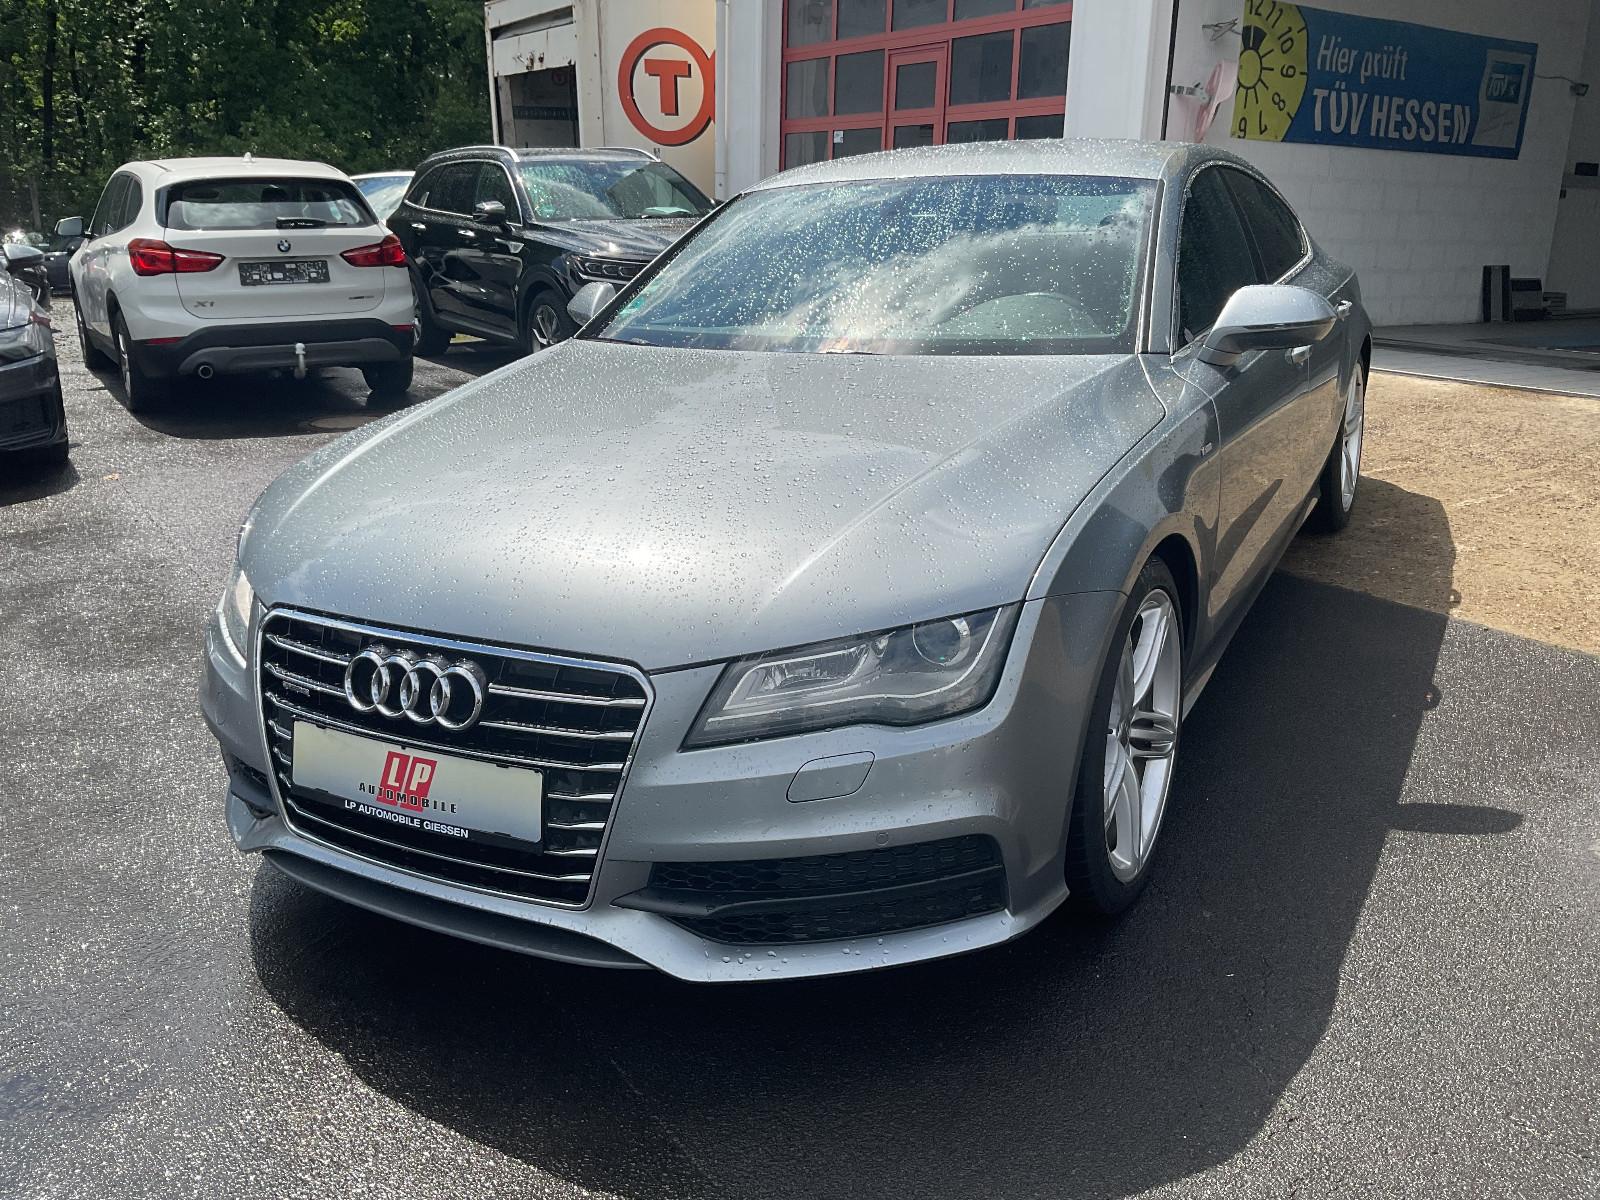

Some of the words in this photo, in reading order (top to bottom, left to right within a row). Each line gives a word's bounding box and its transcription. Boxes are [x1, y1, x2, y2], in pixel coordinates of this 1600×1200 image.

[1266, 1, 1283, 28] 11
[1278, 27, 1294, 54] 10
[1316, 35, 1358, 74] Hier
[1361, 46, 1408, 85] prüft
[1272, 92, 1286, 111] 8
[1313, 82, 1372, 136] TÜV
[1371, 93, 1472, 145] HESSEN
[386, 757, 432, 791] LP
[358, 782, 458, 814] AUTOMOBILE
[344, 800, 357, 810] LP
[358, 803, 421, 828] AUTOMOBILE
[423, 820, 469, 839] GIESSEN
